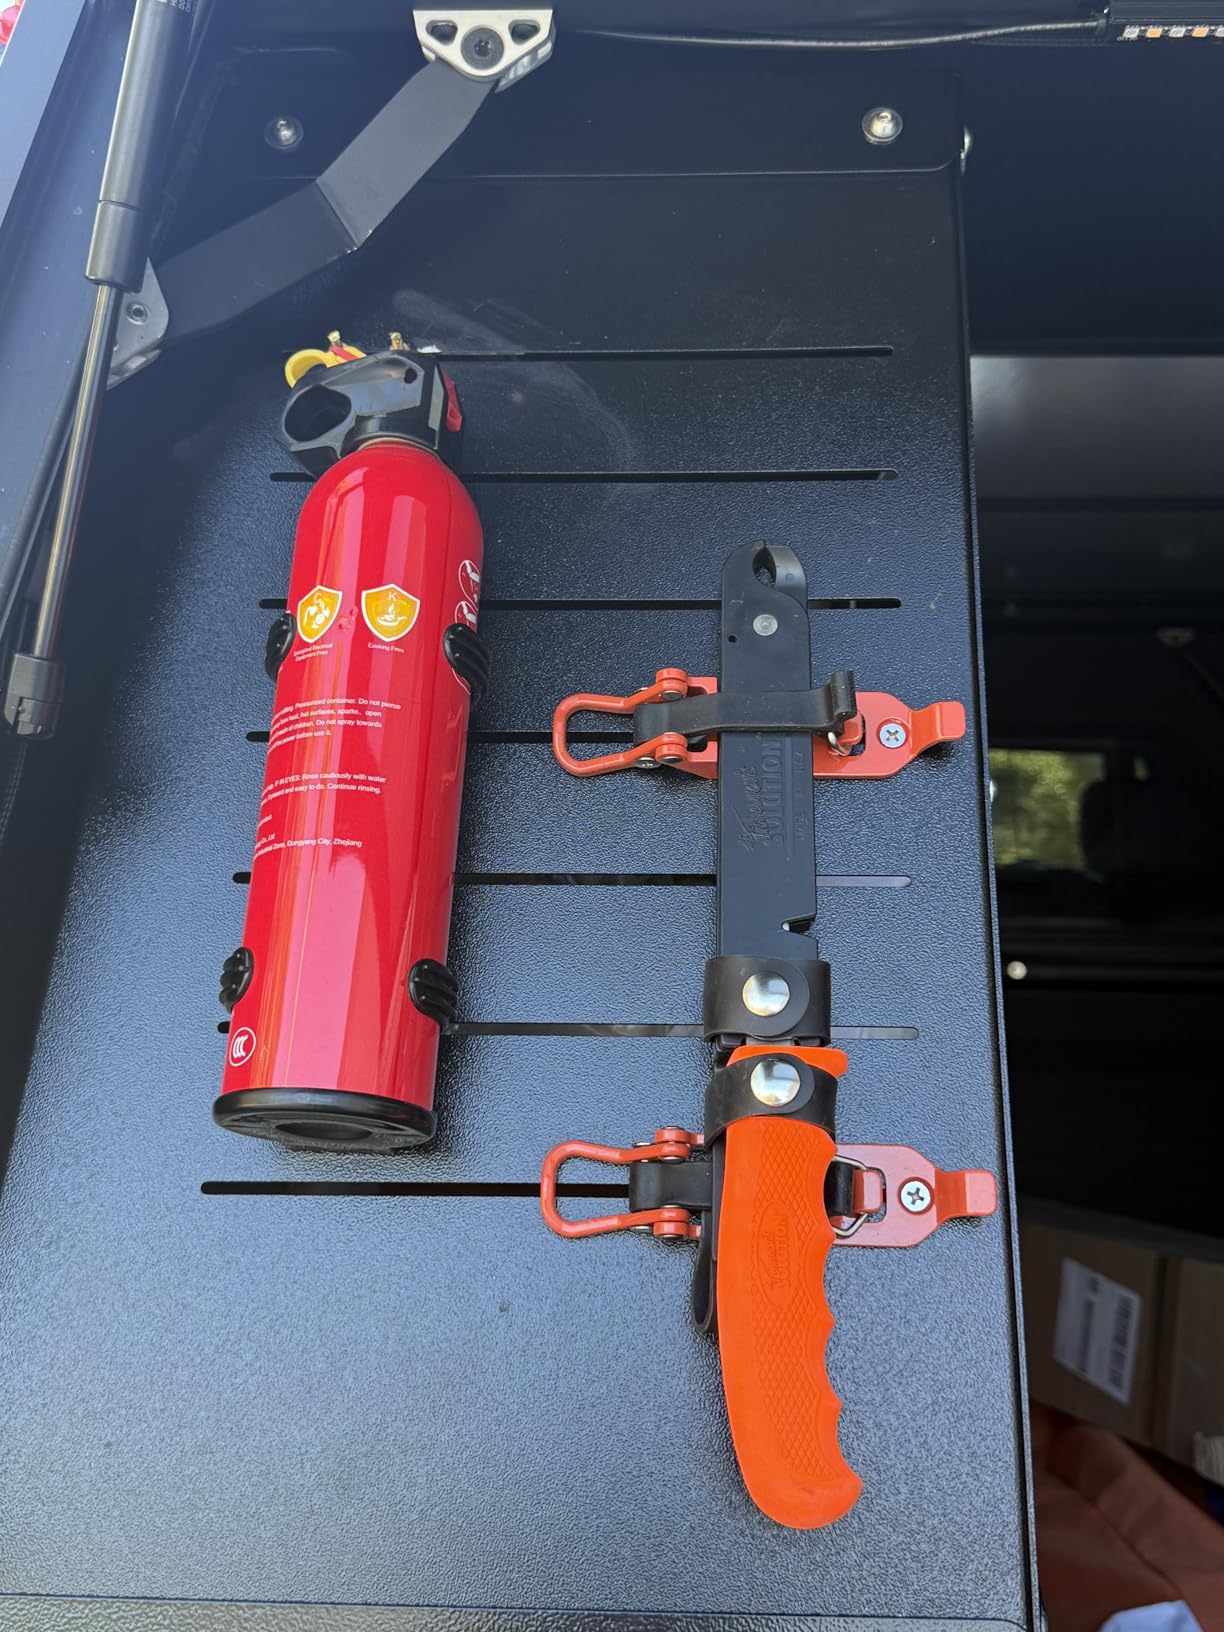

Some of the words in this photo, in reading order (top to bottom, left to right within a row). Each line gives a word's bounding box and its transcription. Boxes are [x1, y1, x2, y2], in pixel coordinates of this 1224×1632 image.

[388, 592, 397, 601] K
[367, 642, 391, 651] Cooking
[381, 701, 401, 710] pierce
[337, 719, 355, 727] spray
[356, 719, 383, 728] towards
[295, 732, 314, 740] before
[320, 772, 352, 780] cautiously
[294, 785, 308, 793] easy
[327, 782, 357, 791] Continue
[357, 784, 382, 794] rinsing.
[286, 839, 317, 847] Dongyang
[333, 837, 363, 848] Zhejiang
